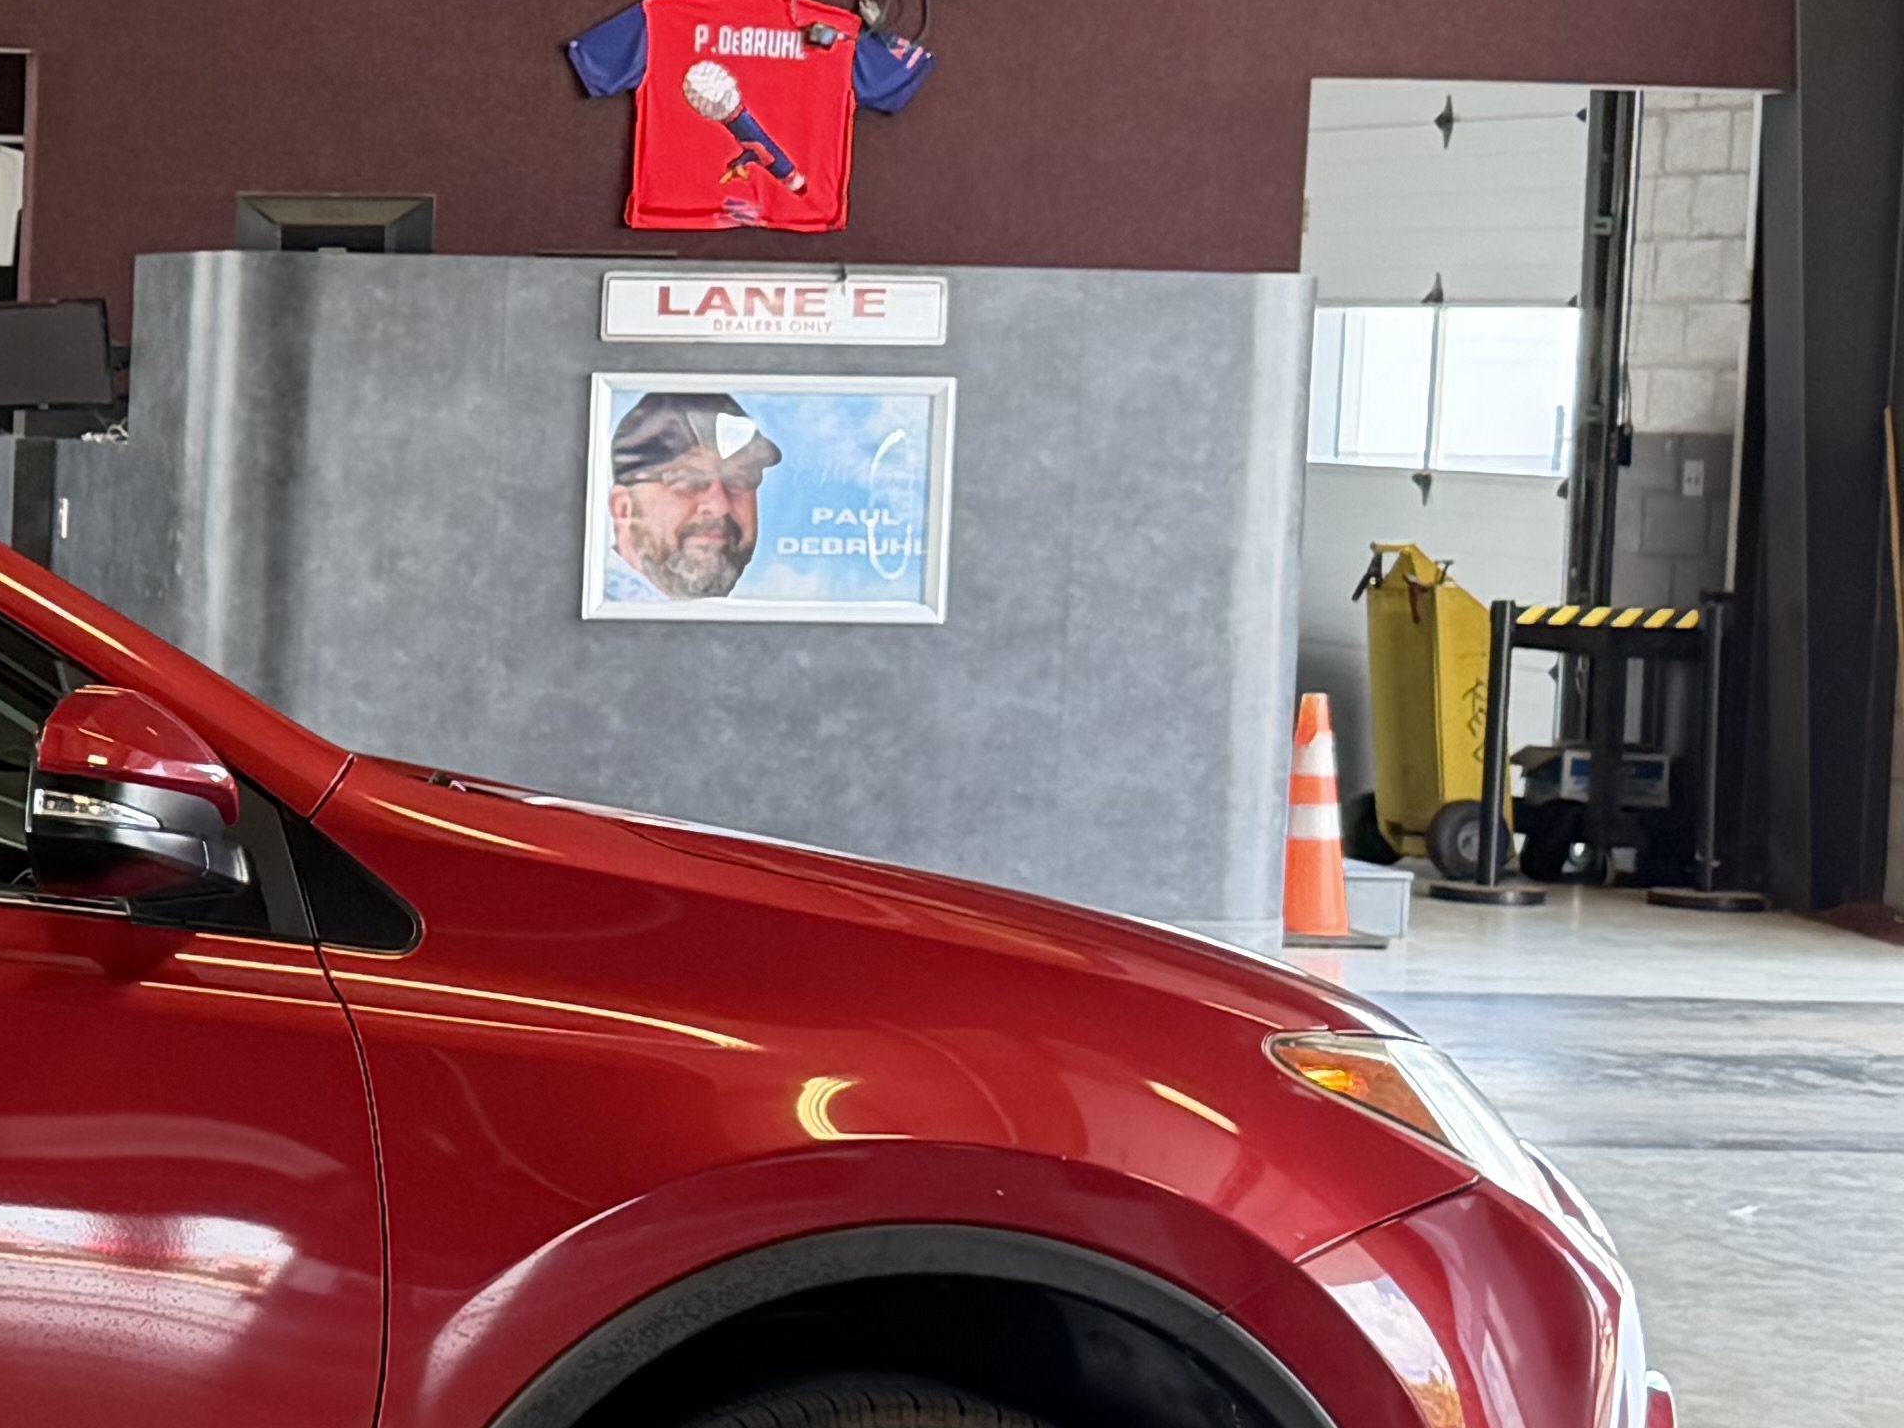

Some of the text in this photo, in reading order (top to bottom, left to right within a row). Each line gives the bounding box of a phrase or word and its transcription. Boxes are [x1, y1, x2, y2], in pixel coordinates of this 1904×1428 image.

[658, 286, 887, 317] LANE E
[712, 319, 833, 334] DEALERS ONLY
[812, 508, 900, 526] PAUL
